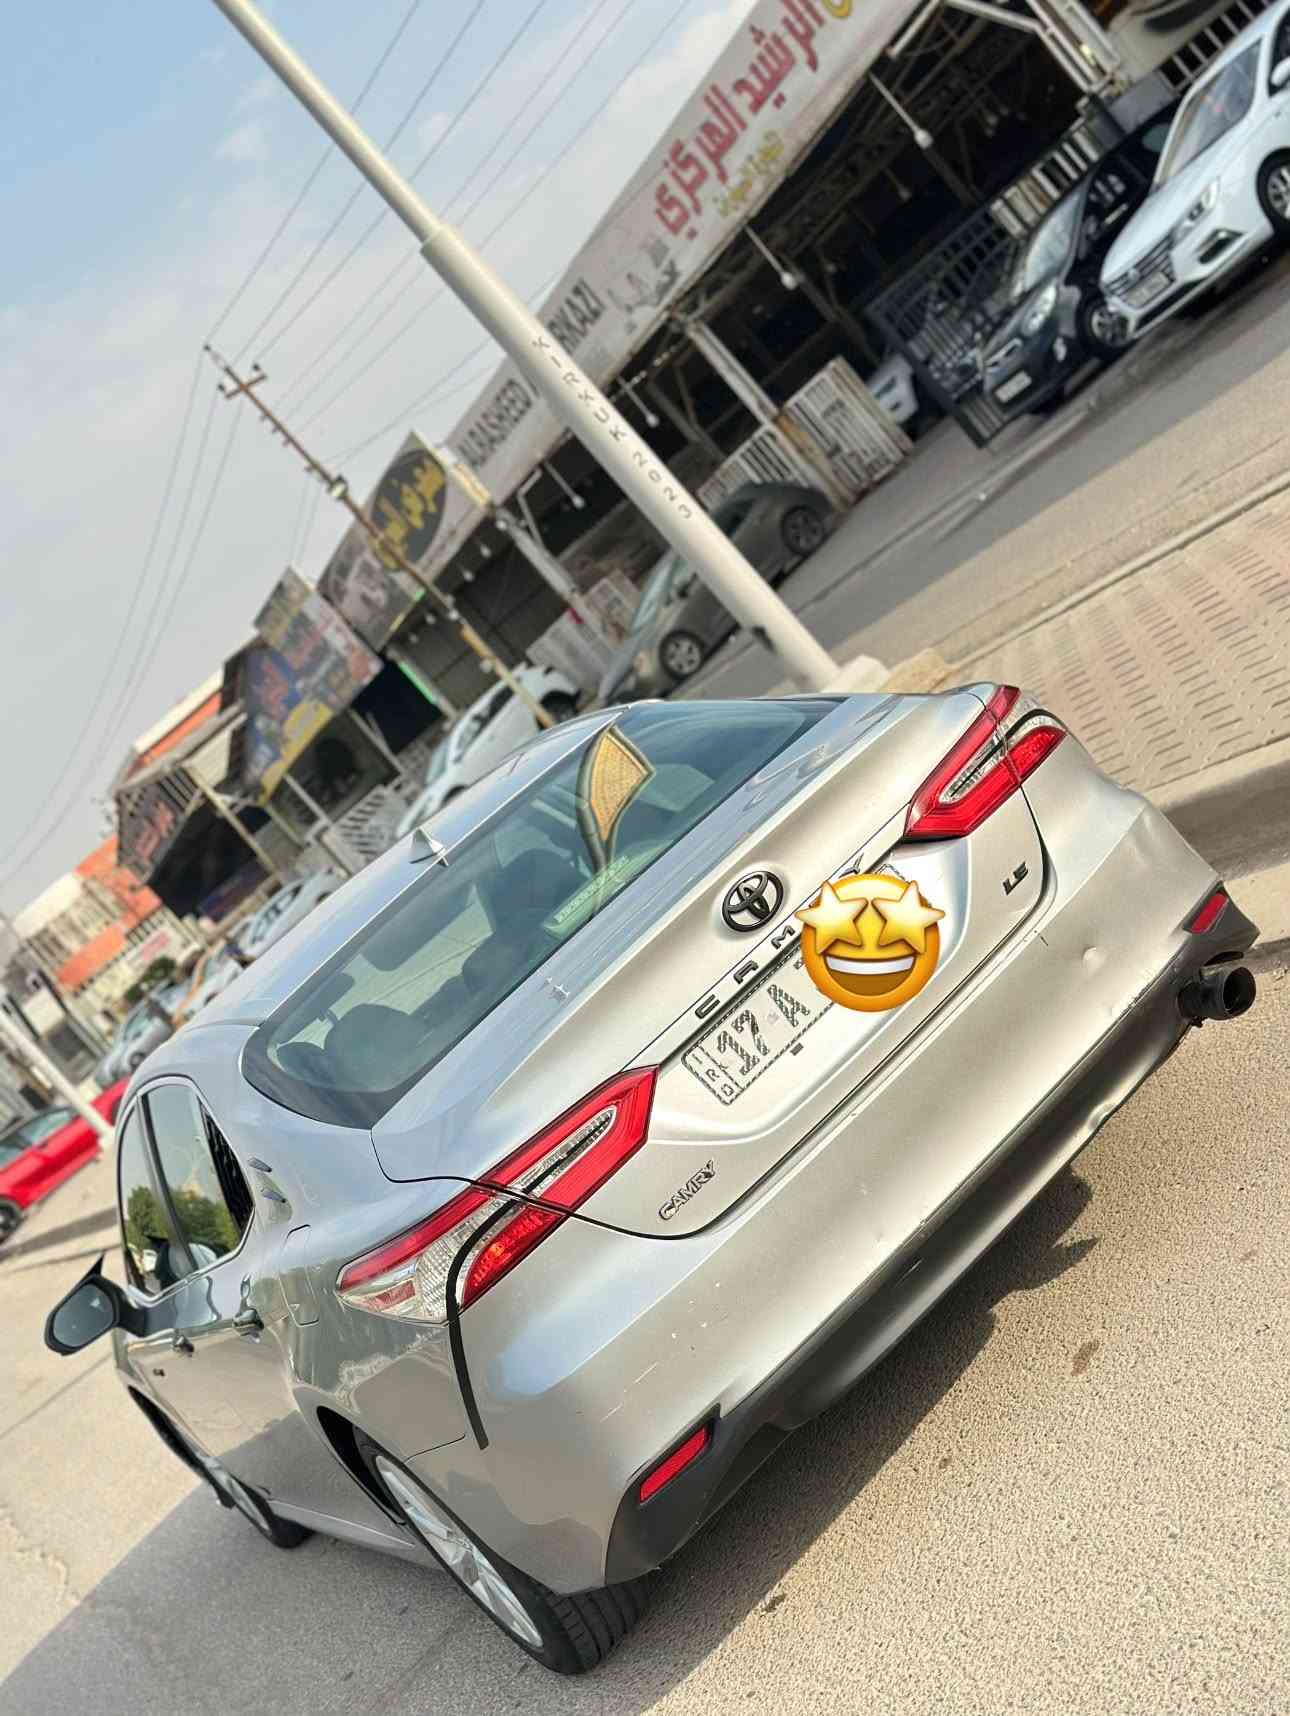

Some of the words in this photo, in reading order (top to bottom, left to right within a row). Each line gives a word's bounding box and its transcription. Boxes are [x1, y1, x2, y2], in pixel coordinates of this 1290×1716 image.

[532, 335, 628, 443] KIRKUK
[632, 451, 692, 519] 2023
[1001, 861, 1029, 896] LE
[717, 1010, 770, 1075] 17
[767, 984, 810, 1027] A
[658, 1159, 716, 1221] CAMRY
